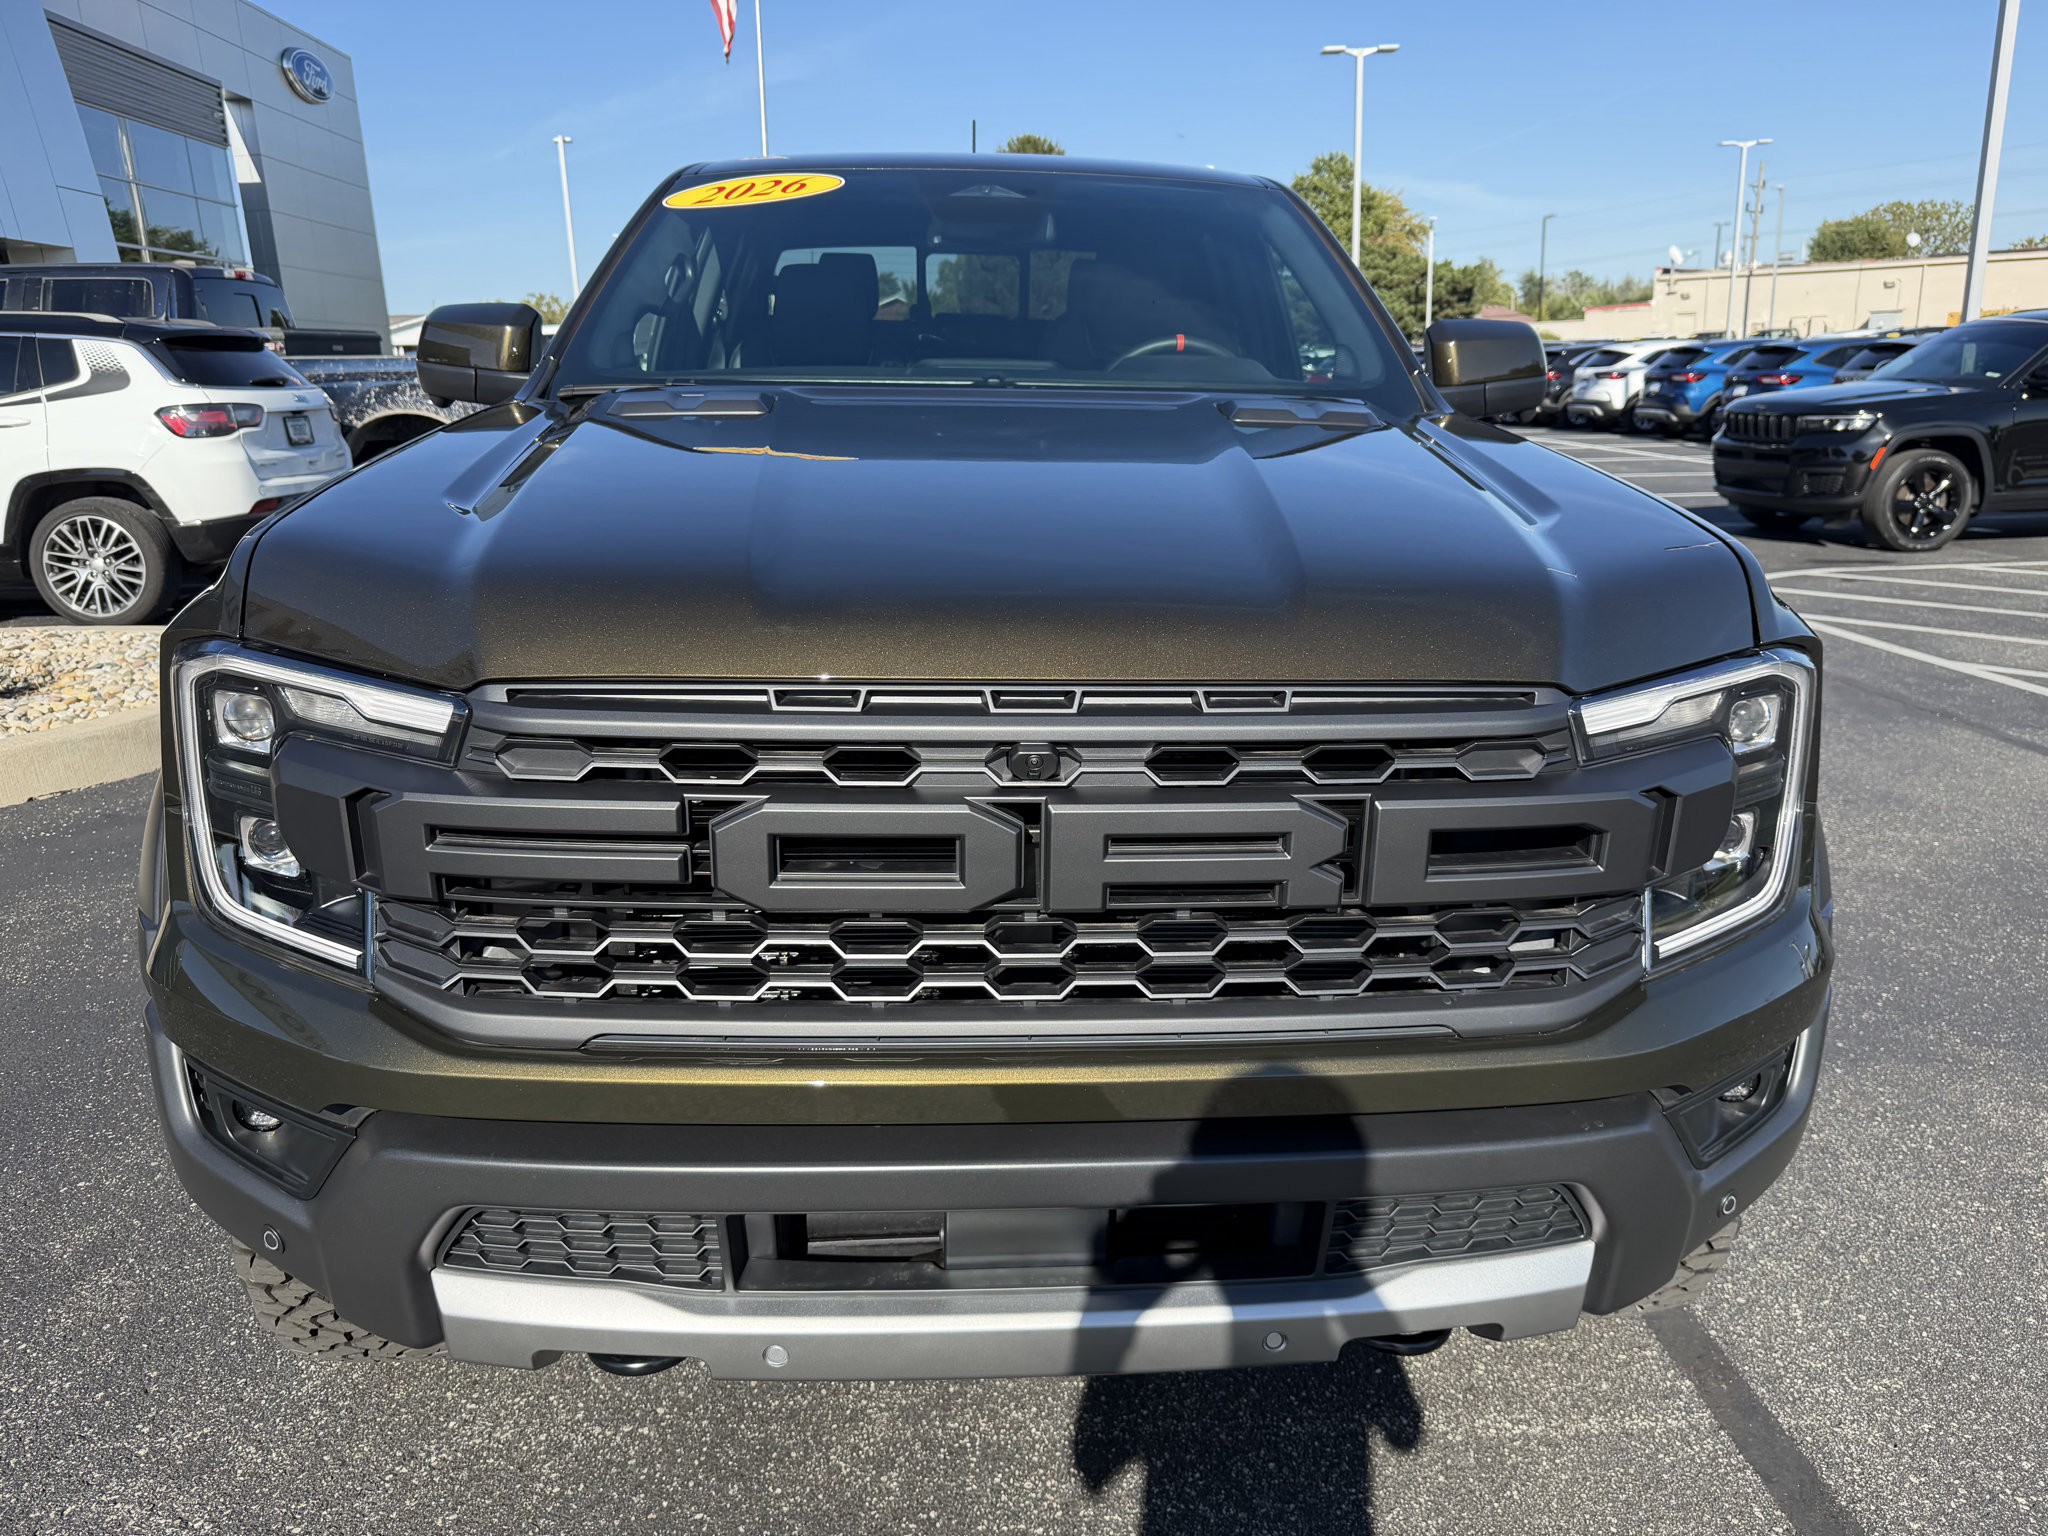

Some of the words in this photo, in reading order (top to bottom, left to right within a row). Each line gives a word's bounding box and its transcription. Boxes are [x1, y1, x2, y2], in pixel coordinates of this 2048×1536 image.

[303, 60, 328, 95] Ford
[691, 177, 816, 204] 2026
[366, 792, 1660, 911] FORD
